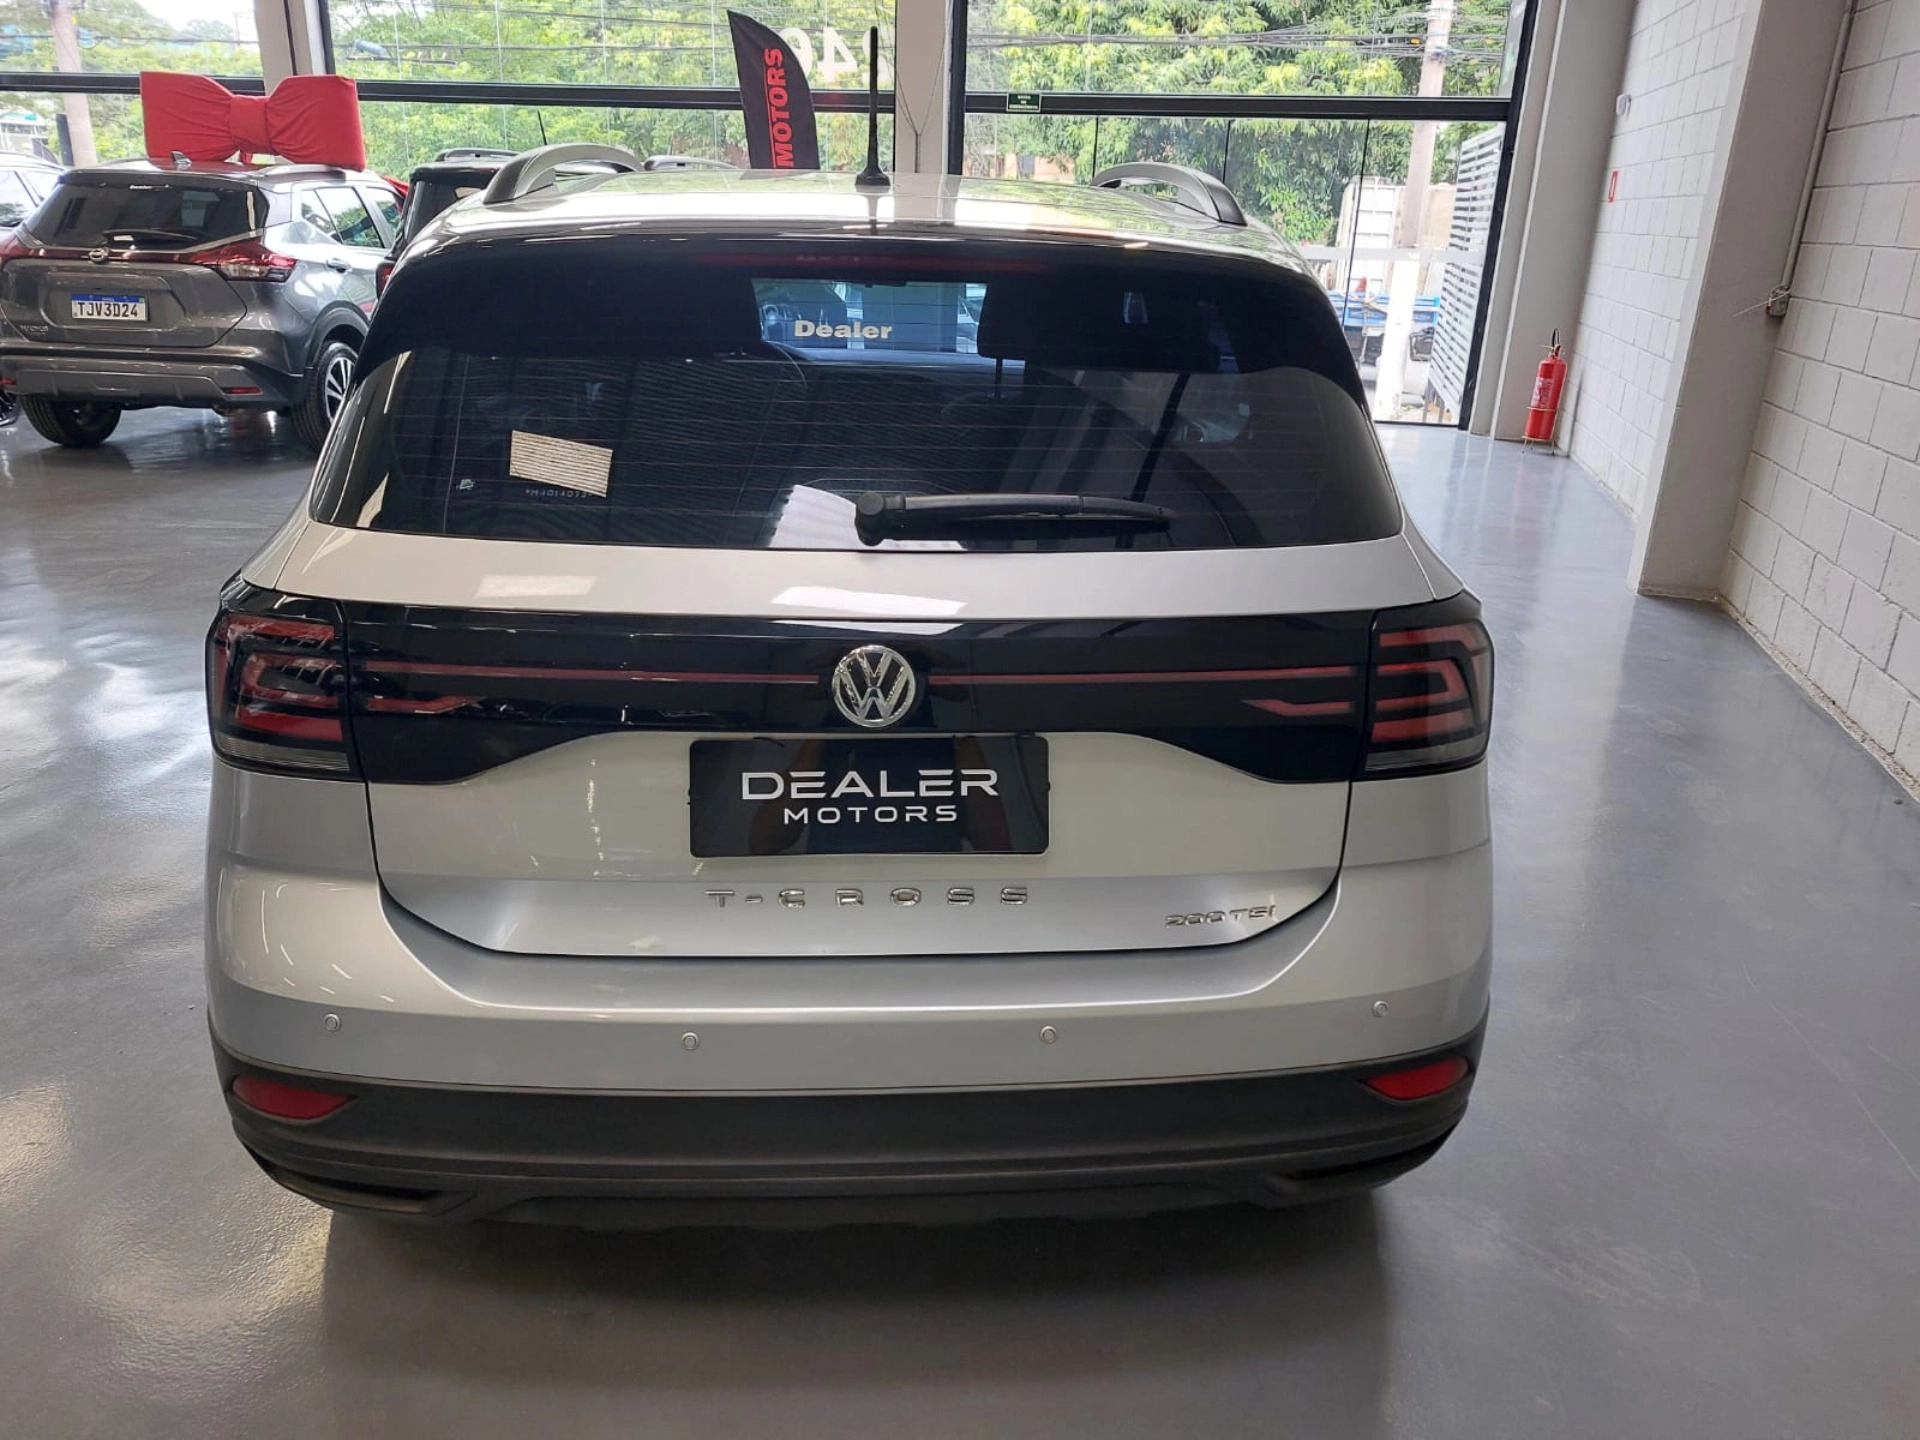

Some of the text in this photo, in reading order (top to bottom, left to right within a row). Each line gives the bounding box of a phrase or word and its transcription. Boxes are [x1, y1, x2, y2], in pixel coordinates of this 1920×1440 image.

[764, 48, 795, 167] MOTORS
[78, 301, 138, 317] TJV3D24
[794, 320, 893, 339] Dealer
[742, 768, 999, 800] DEALER
[783, 805, 958, 825] MOTORS
[704, 888, 1029, 909] T-CROSS
